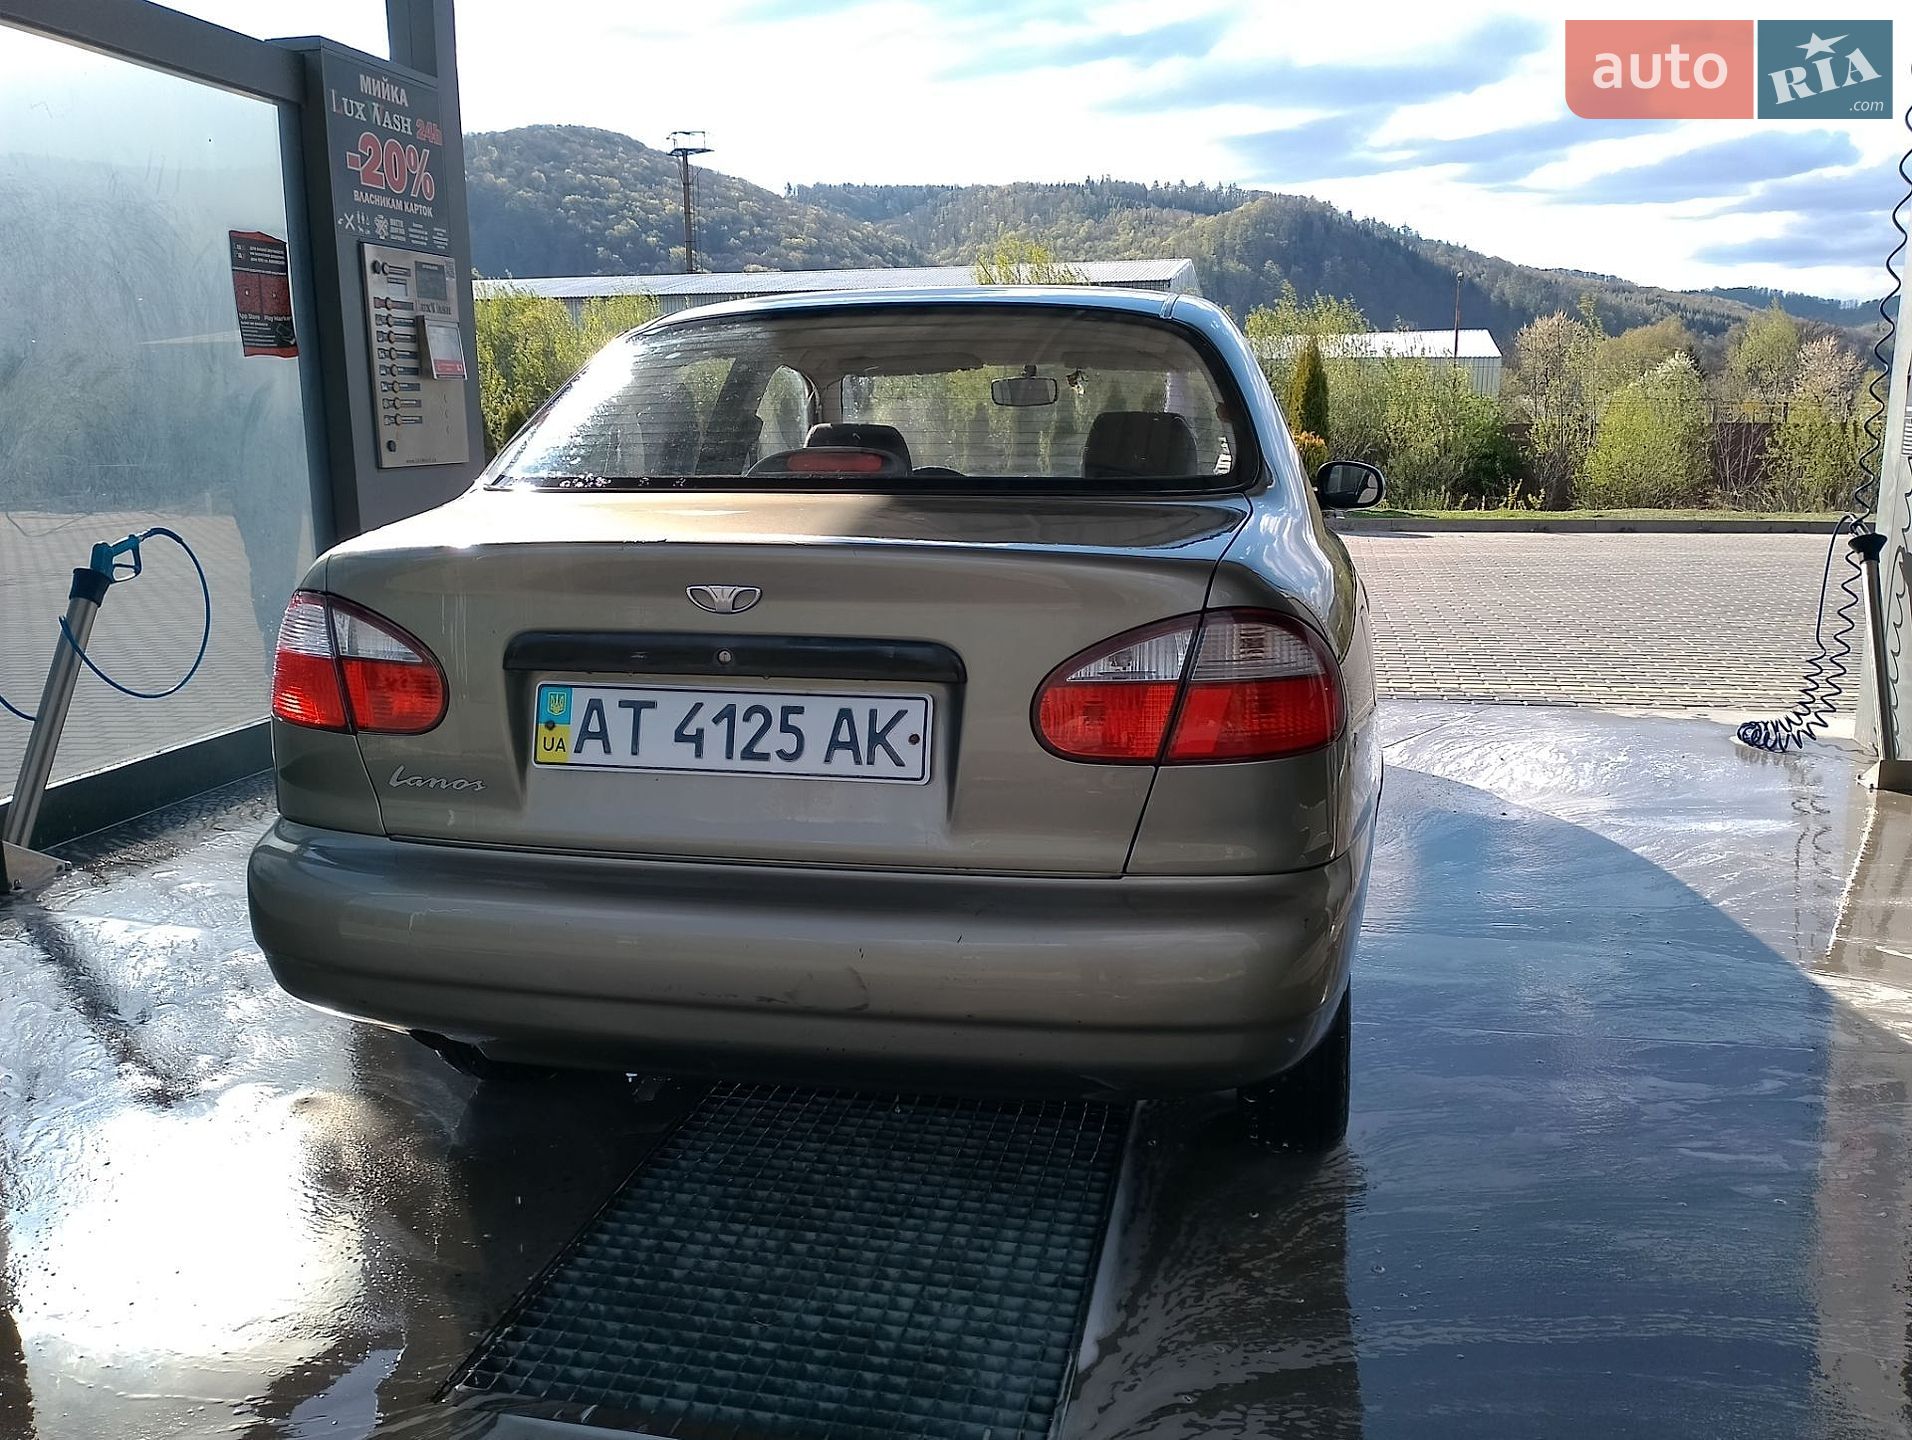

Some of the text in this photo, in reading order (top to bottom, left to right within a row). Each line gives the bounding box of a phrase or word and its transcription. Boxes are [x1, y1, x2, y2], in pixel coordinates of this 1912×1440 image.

[359, 74, 409, 107] МИЙКА
[346, 131, 435, 201] -20%
[353, 190, 433, 218] ВЛАСНИКАМ КАРТОК
[543, 736, 567, 753] UA
[573, 698, 910, 768] AT 4125 AK
[388, 765, 487, 791] Lanos
